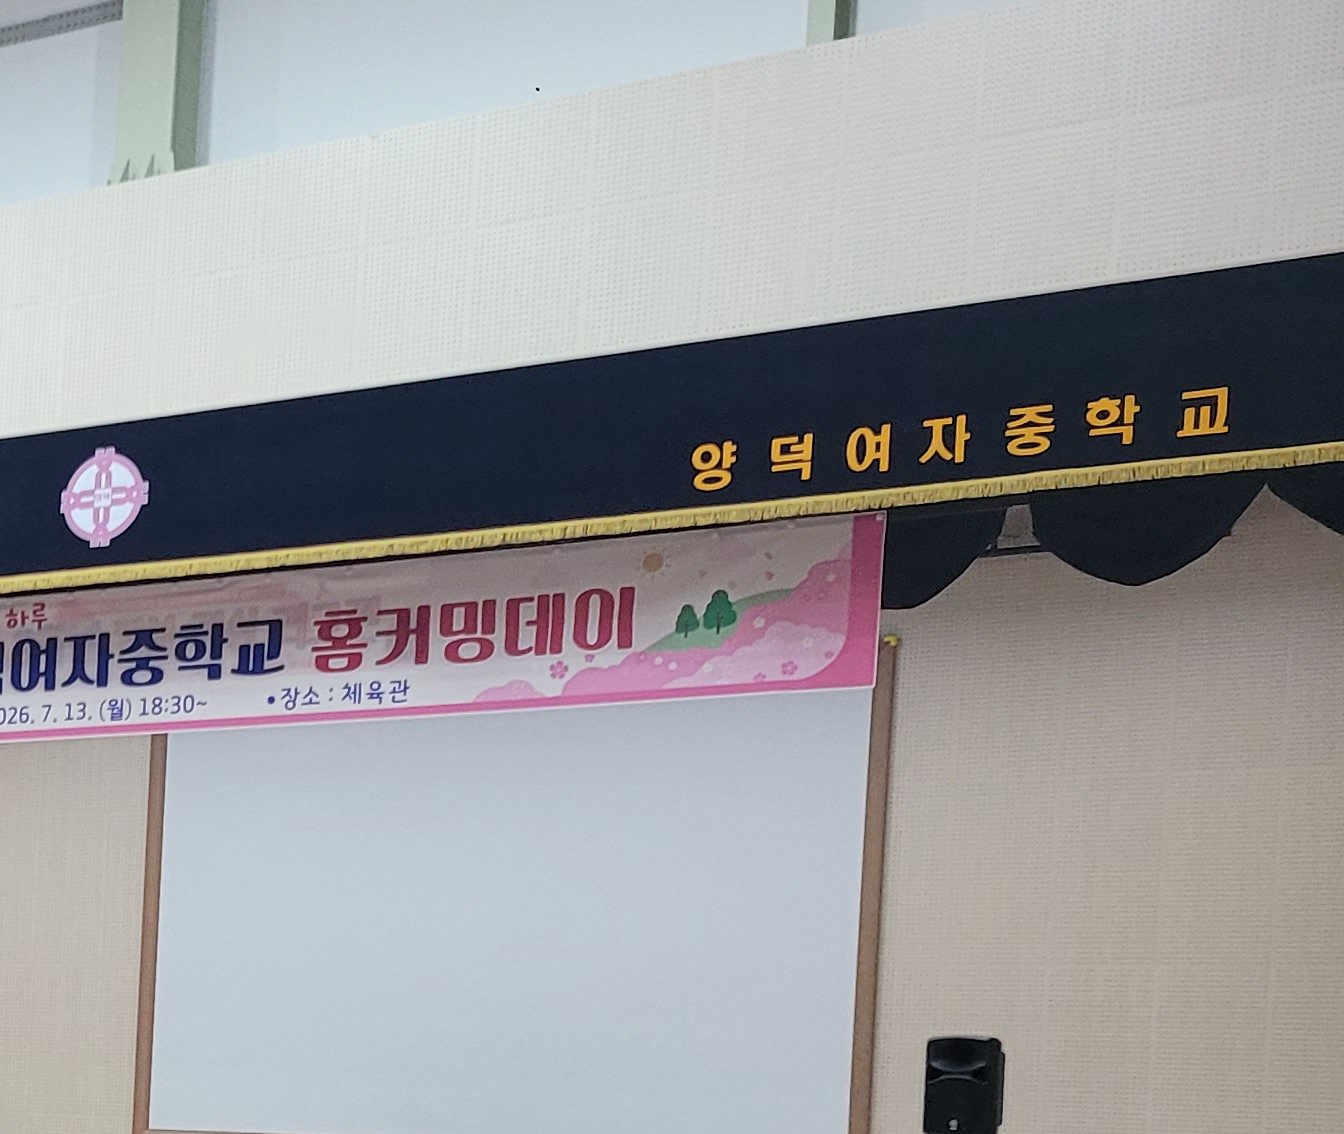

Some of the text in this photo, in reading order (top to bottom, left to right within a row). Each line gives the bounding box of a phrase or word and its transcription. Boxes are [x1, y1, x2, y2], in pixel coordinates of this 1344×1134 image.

[691, 386, 1230, 491] 양덕여자중학교
[5, 602, 48, 630] 하루
[311, 586, 637, 674] 홈커밍데이
[41, 704, 58, 724] 7.
[63, 703, 93, 723] 13.
[98, 698, 132, 724] (월)
[139, 694, 208, 718] 18:30~
[280, 684, 320, 709] 장소
[341, 680, 411, 706] 체육관
